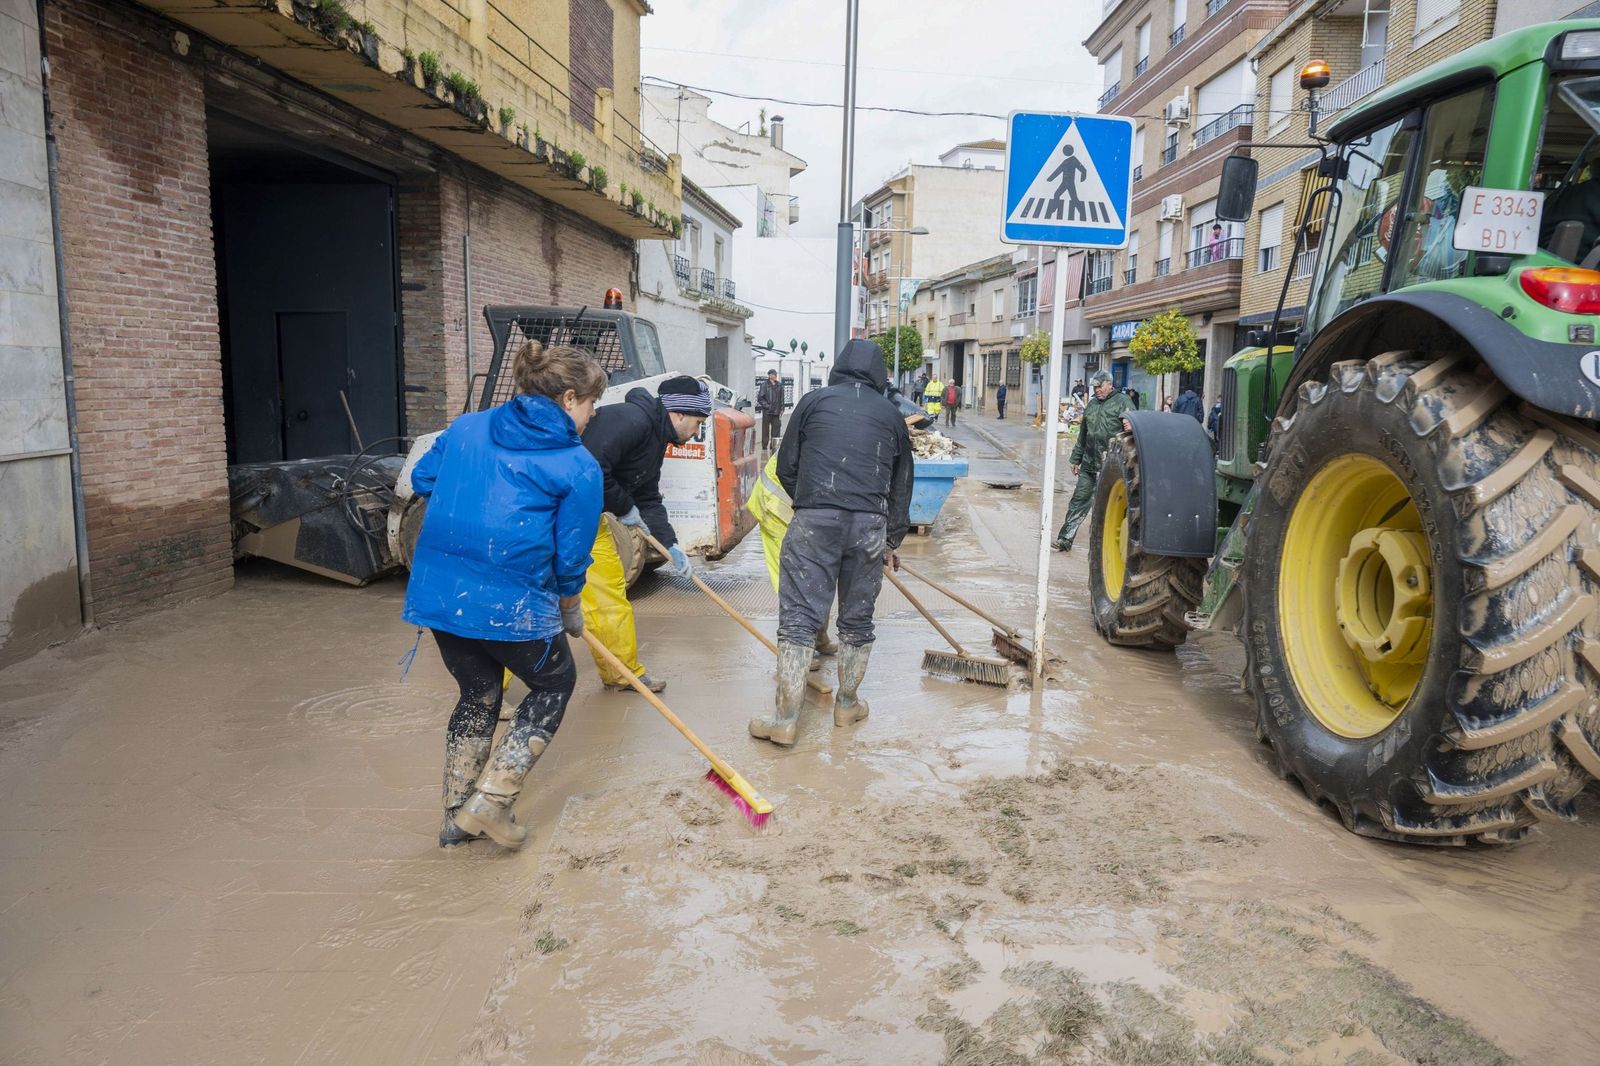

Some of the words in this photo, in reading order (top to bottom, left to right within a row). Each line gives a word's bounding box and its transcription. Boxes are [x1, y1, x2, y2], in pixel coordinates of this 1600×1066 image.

[1473, 194, 1486, 214] E
[1491, 196, 1537, 217] 3343
[1481, 228, 1521, 250] BDY
[671, 446, 702, 458] Bobcat
